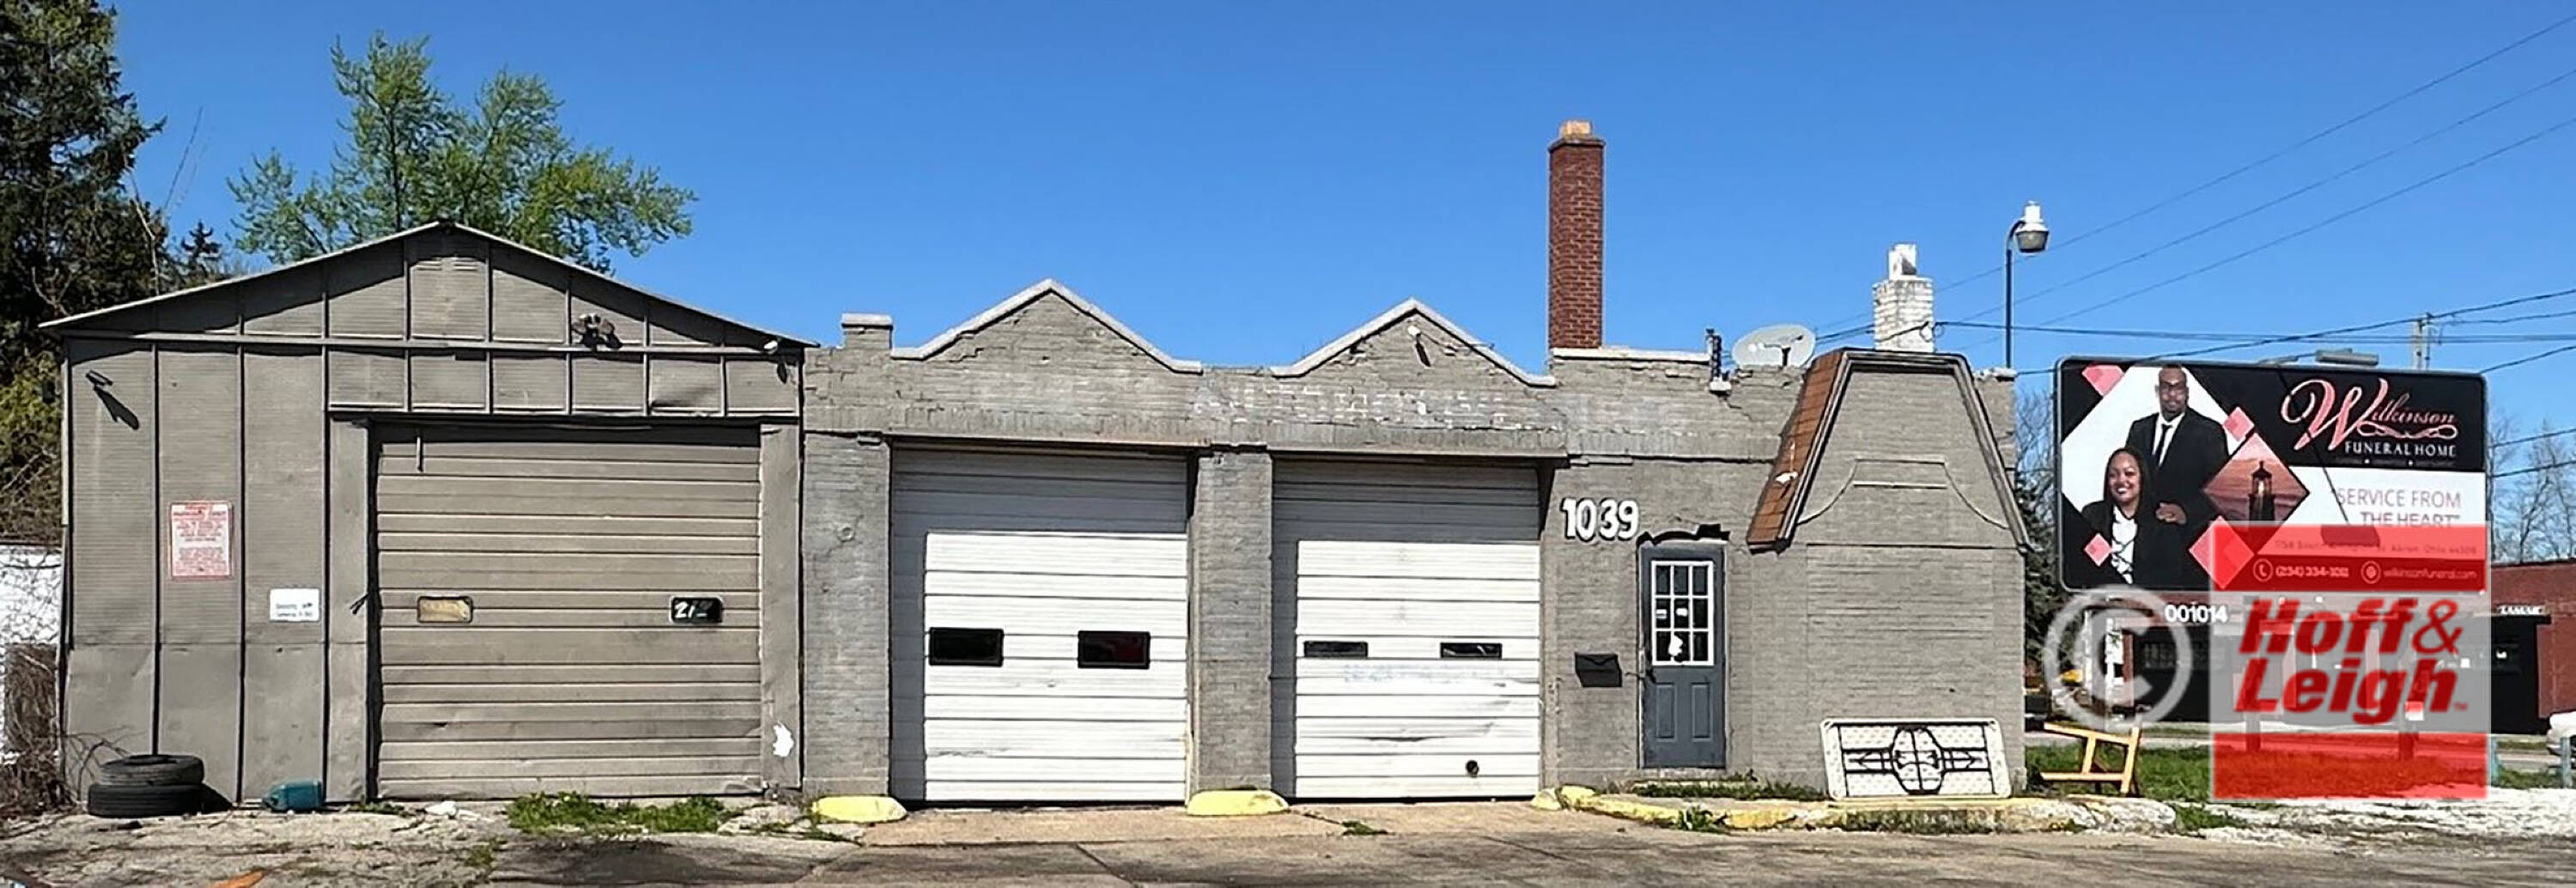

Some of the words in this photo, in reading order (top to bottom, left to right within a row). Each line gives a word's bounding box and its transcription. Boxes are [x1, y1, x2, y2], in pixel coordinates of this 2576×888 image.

[2281, 378, 2458, 450] Wilkinson
[2344, 441, 2410, 456] FUNERAL
[2414, 444, 2456, 458] HOME
[2411, 490, 2461, 508] FROM
[1560, 497, 1639, 541] 1039
[2360, 511, 2393, 527] THE
[2164, 604, 2228, 623] 001014
